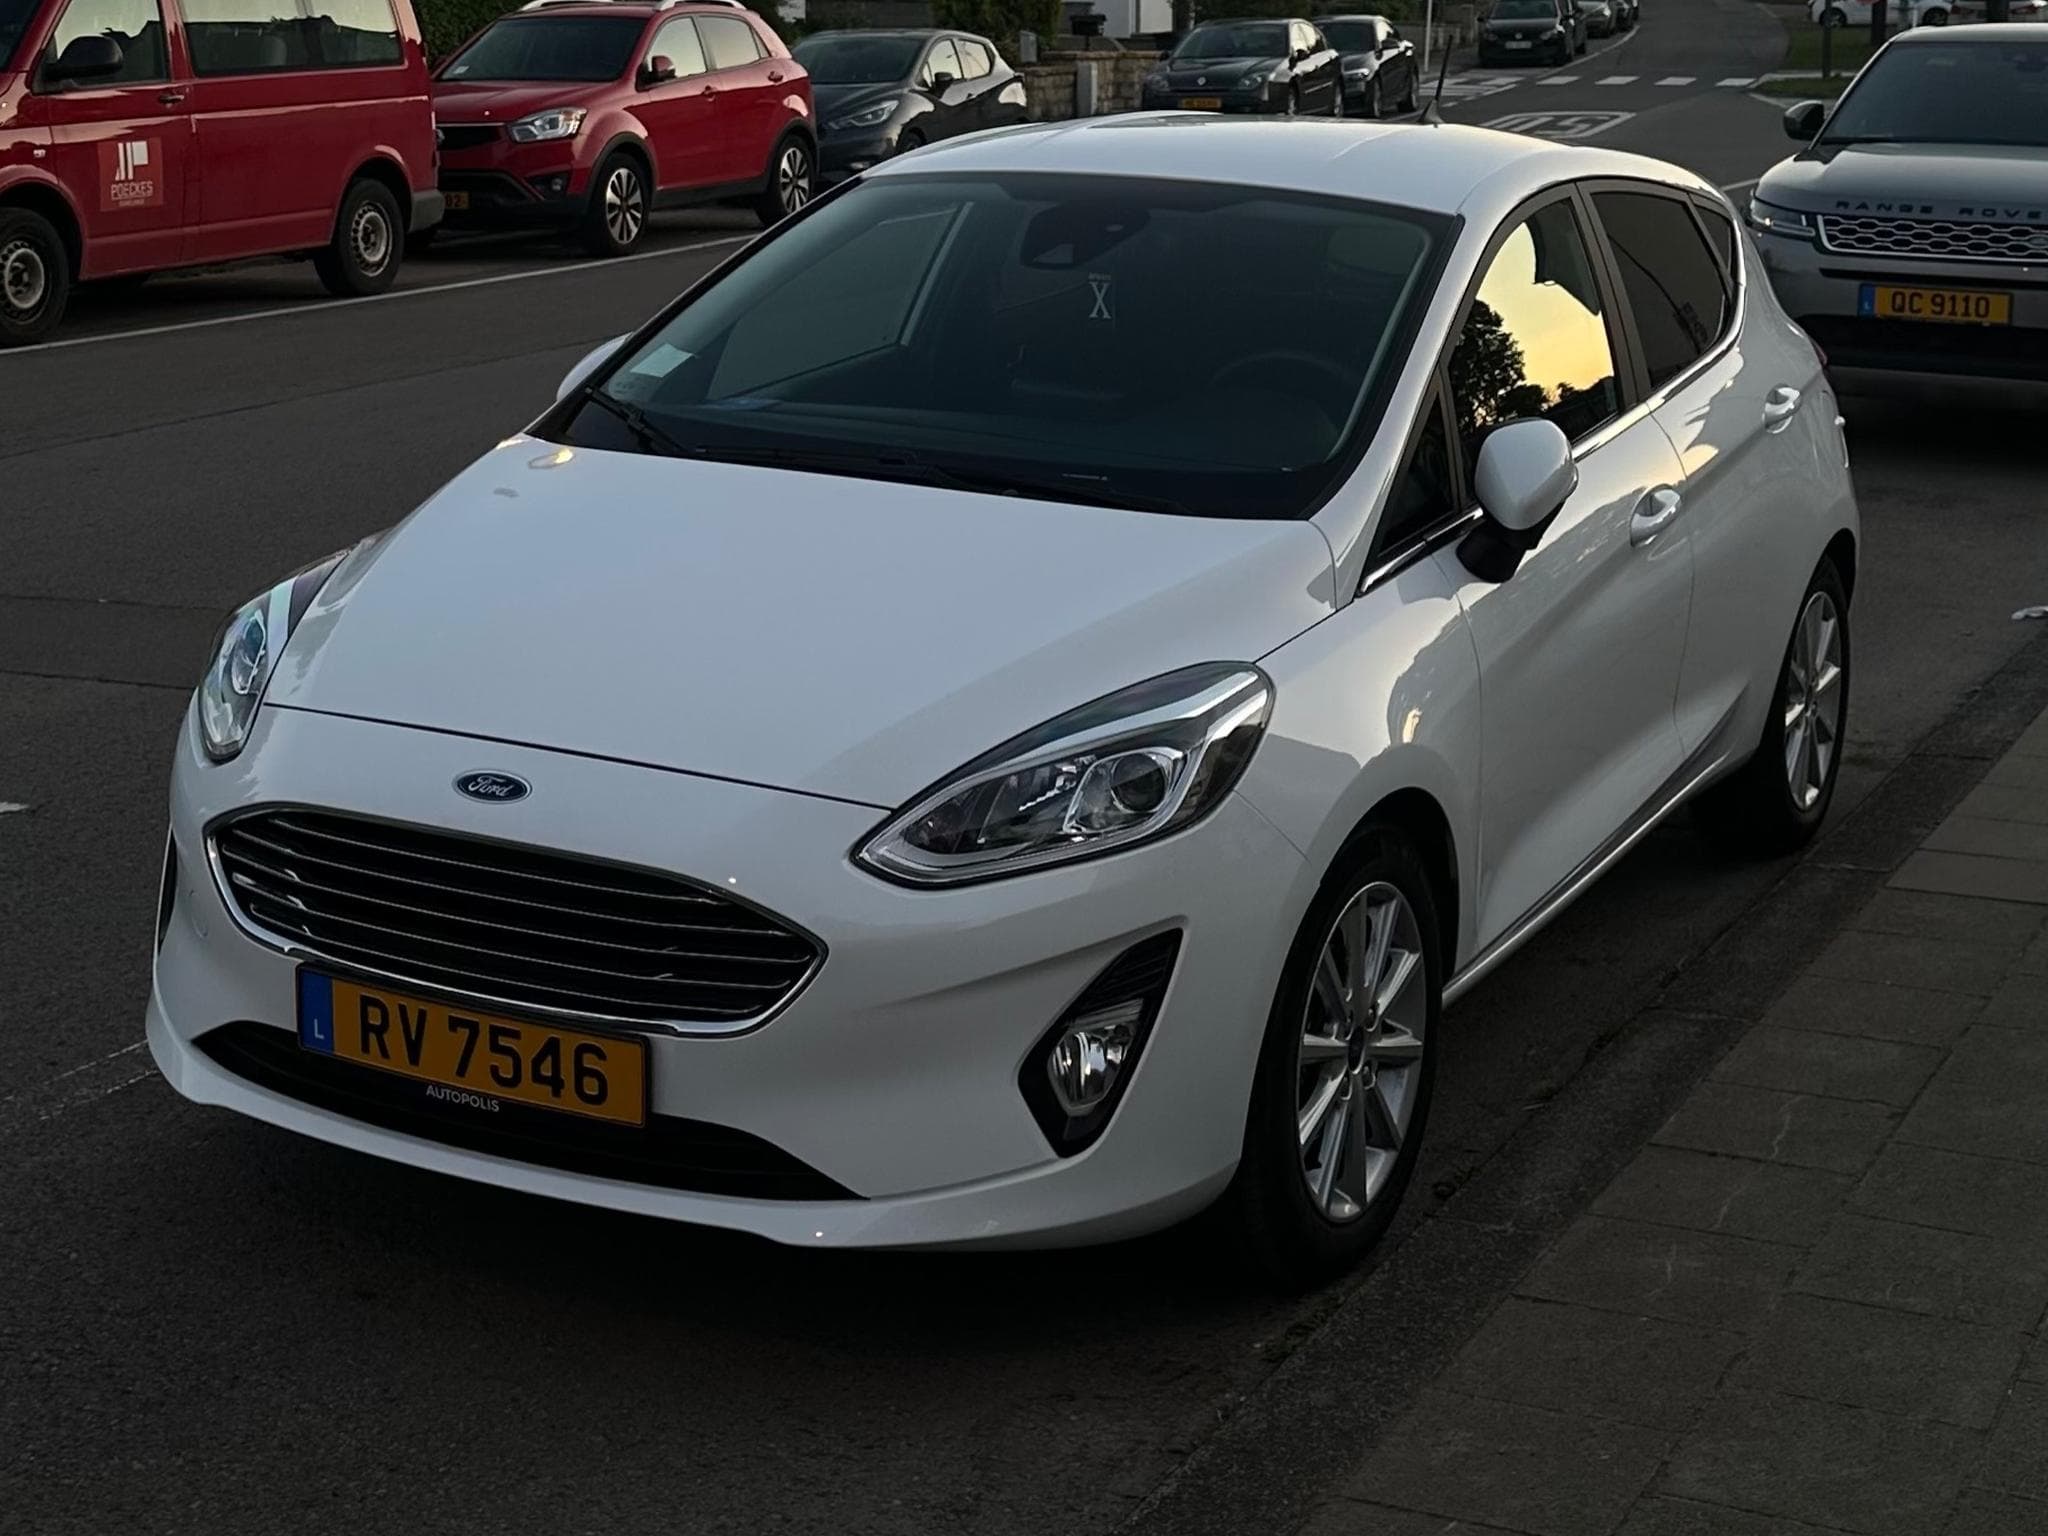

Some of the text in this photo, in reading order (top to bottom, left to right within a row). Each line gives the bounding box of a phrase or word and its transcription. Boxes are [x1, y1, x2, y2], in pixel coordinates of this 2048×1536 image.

[1836, 201, 2043, 219] RANGE ROVE
[1891, 290, 1923, 314] QC
[1930, 293, 1990, 318] 9110
[467, 775, 515, 797] Ford
[313, 992, 609, 1106] L RV 7546
[425, 1084, 500, 1113] AUTOPOLIS
